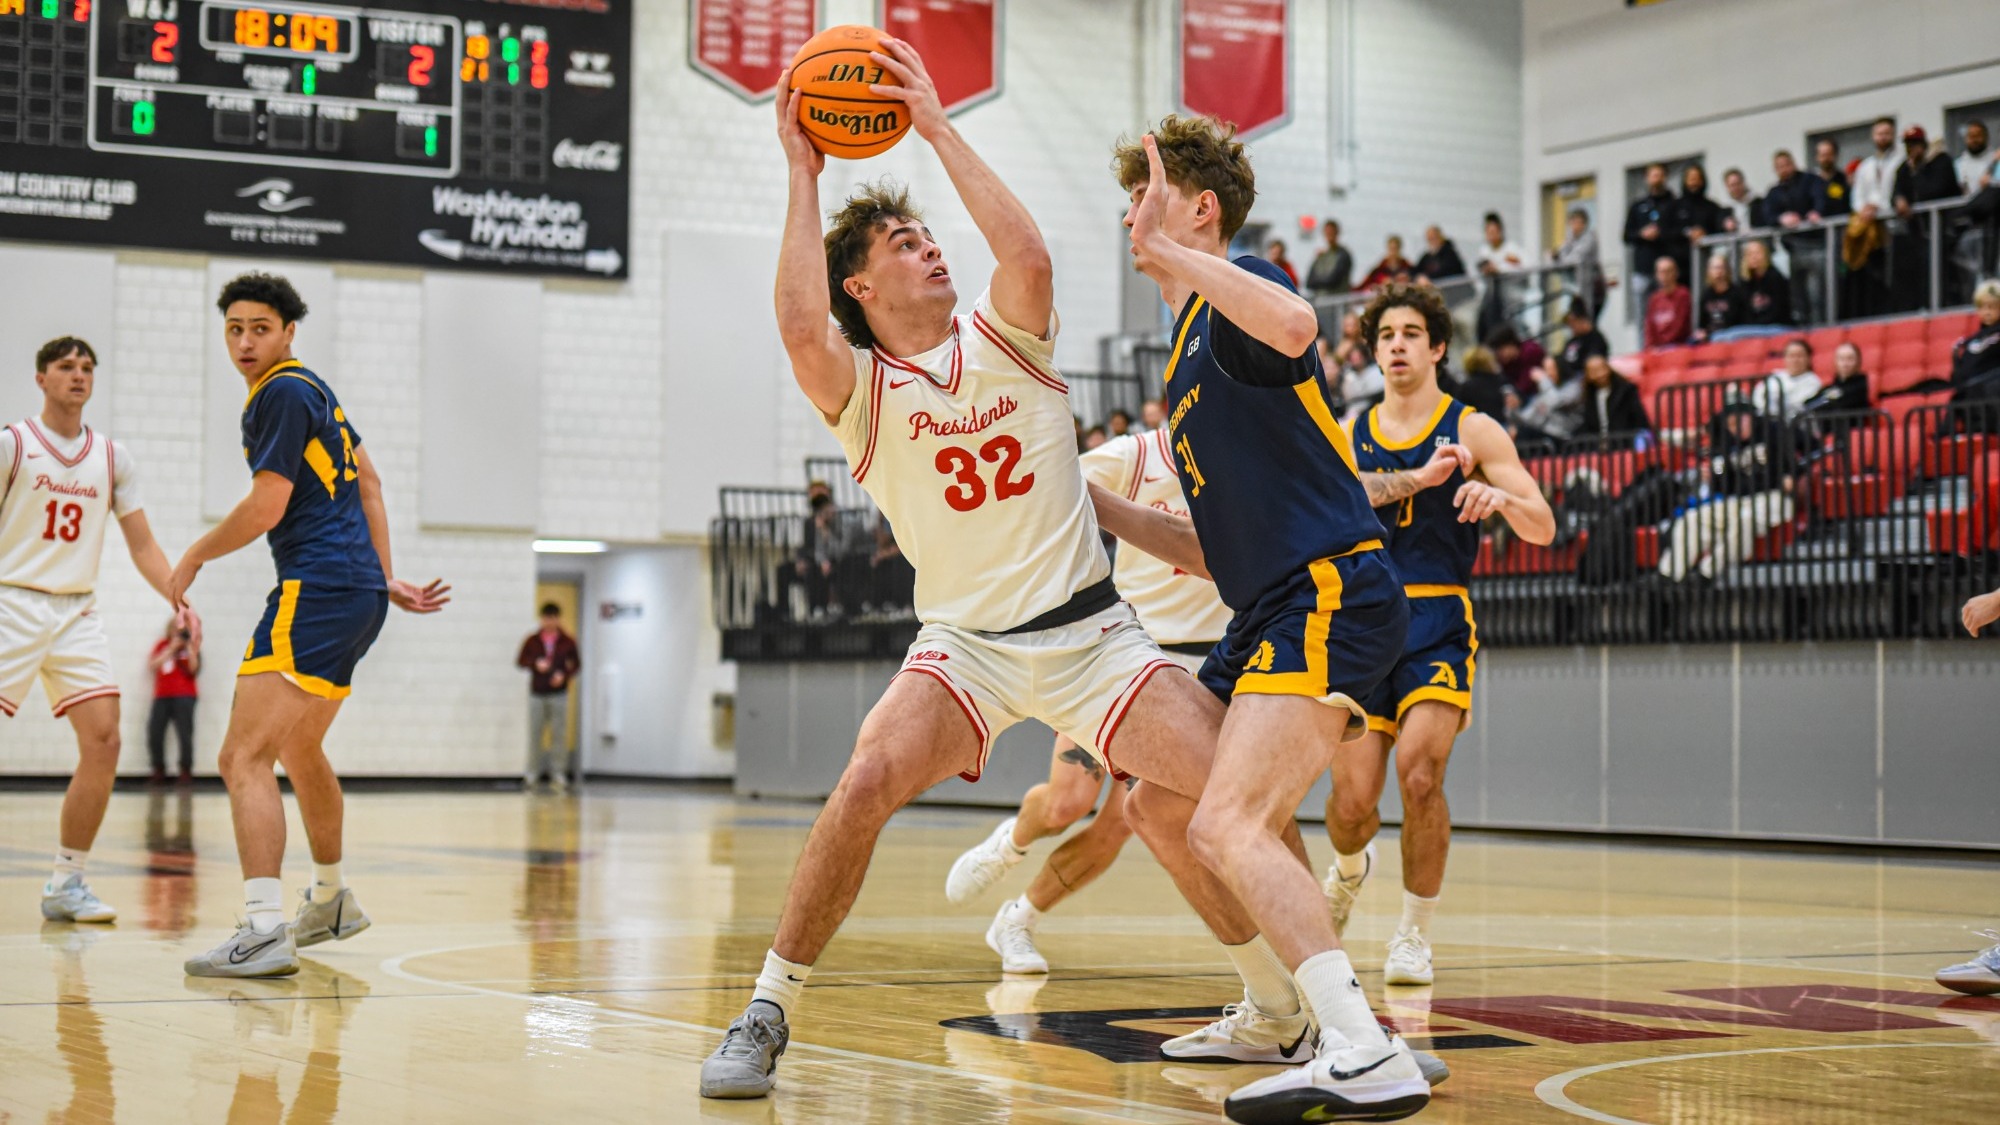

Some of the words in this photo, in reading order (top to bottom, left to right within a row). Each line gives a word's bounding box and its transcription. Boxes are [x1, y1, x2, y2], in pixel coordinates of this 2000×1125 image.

[152, 21, 178, 62] 2
[235, 8, 339, 53] 18:09
[368, 19, 445, 45] VISITOR
[303, 64, 316, 96] 1
[408, 44, 434, 86] 2
[828, 64, 884, 84] EVO
[132, 100, 155, 135] 0
[809, 105, 898, 136] Wilson
[424, 125, 437, 157] 1
[17, 172, 92, 200] COUNTRY
[93, 178, 137, 205] CLUB
[432, 185, 582, 225] Washington
[259, 229, 319, 246] CENTER
[471, 216, 588, 250] Hyundai
[1187, 335, 1200, 357] GB
[908, 395, 1018, 440] Presidents
[934, 434, 1035, 512] 32
[1176, 433, 1206, 498] 31
[32, 473, 98, 499] Presidents
[42, 498, 83, 542] 13
